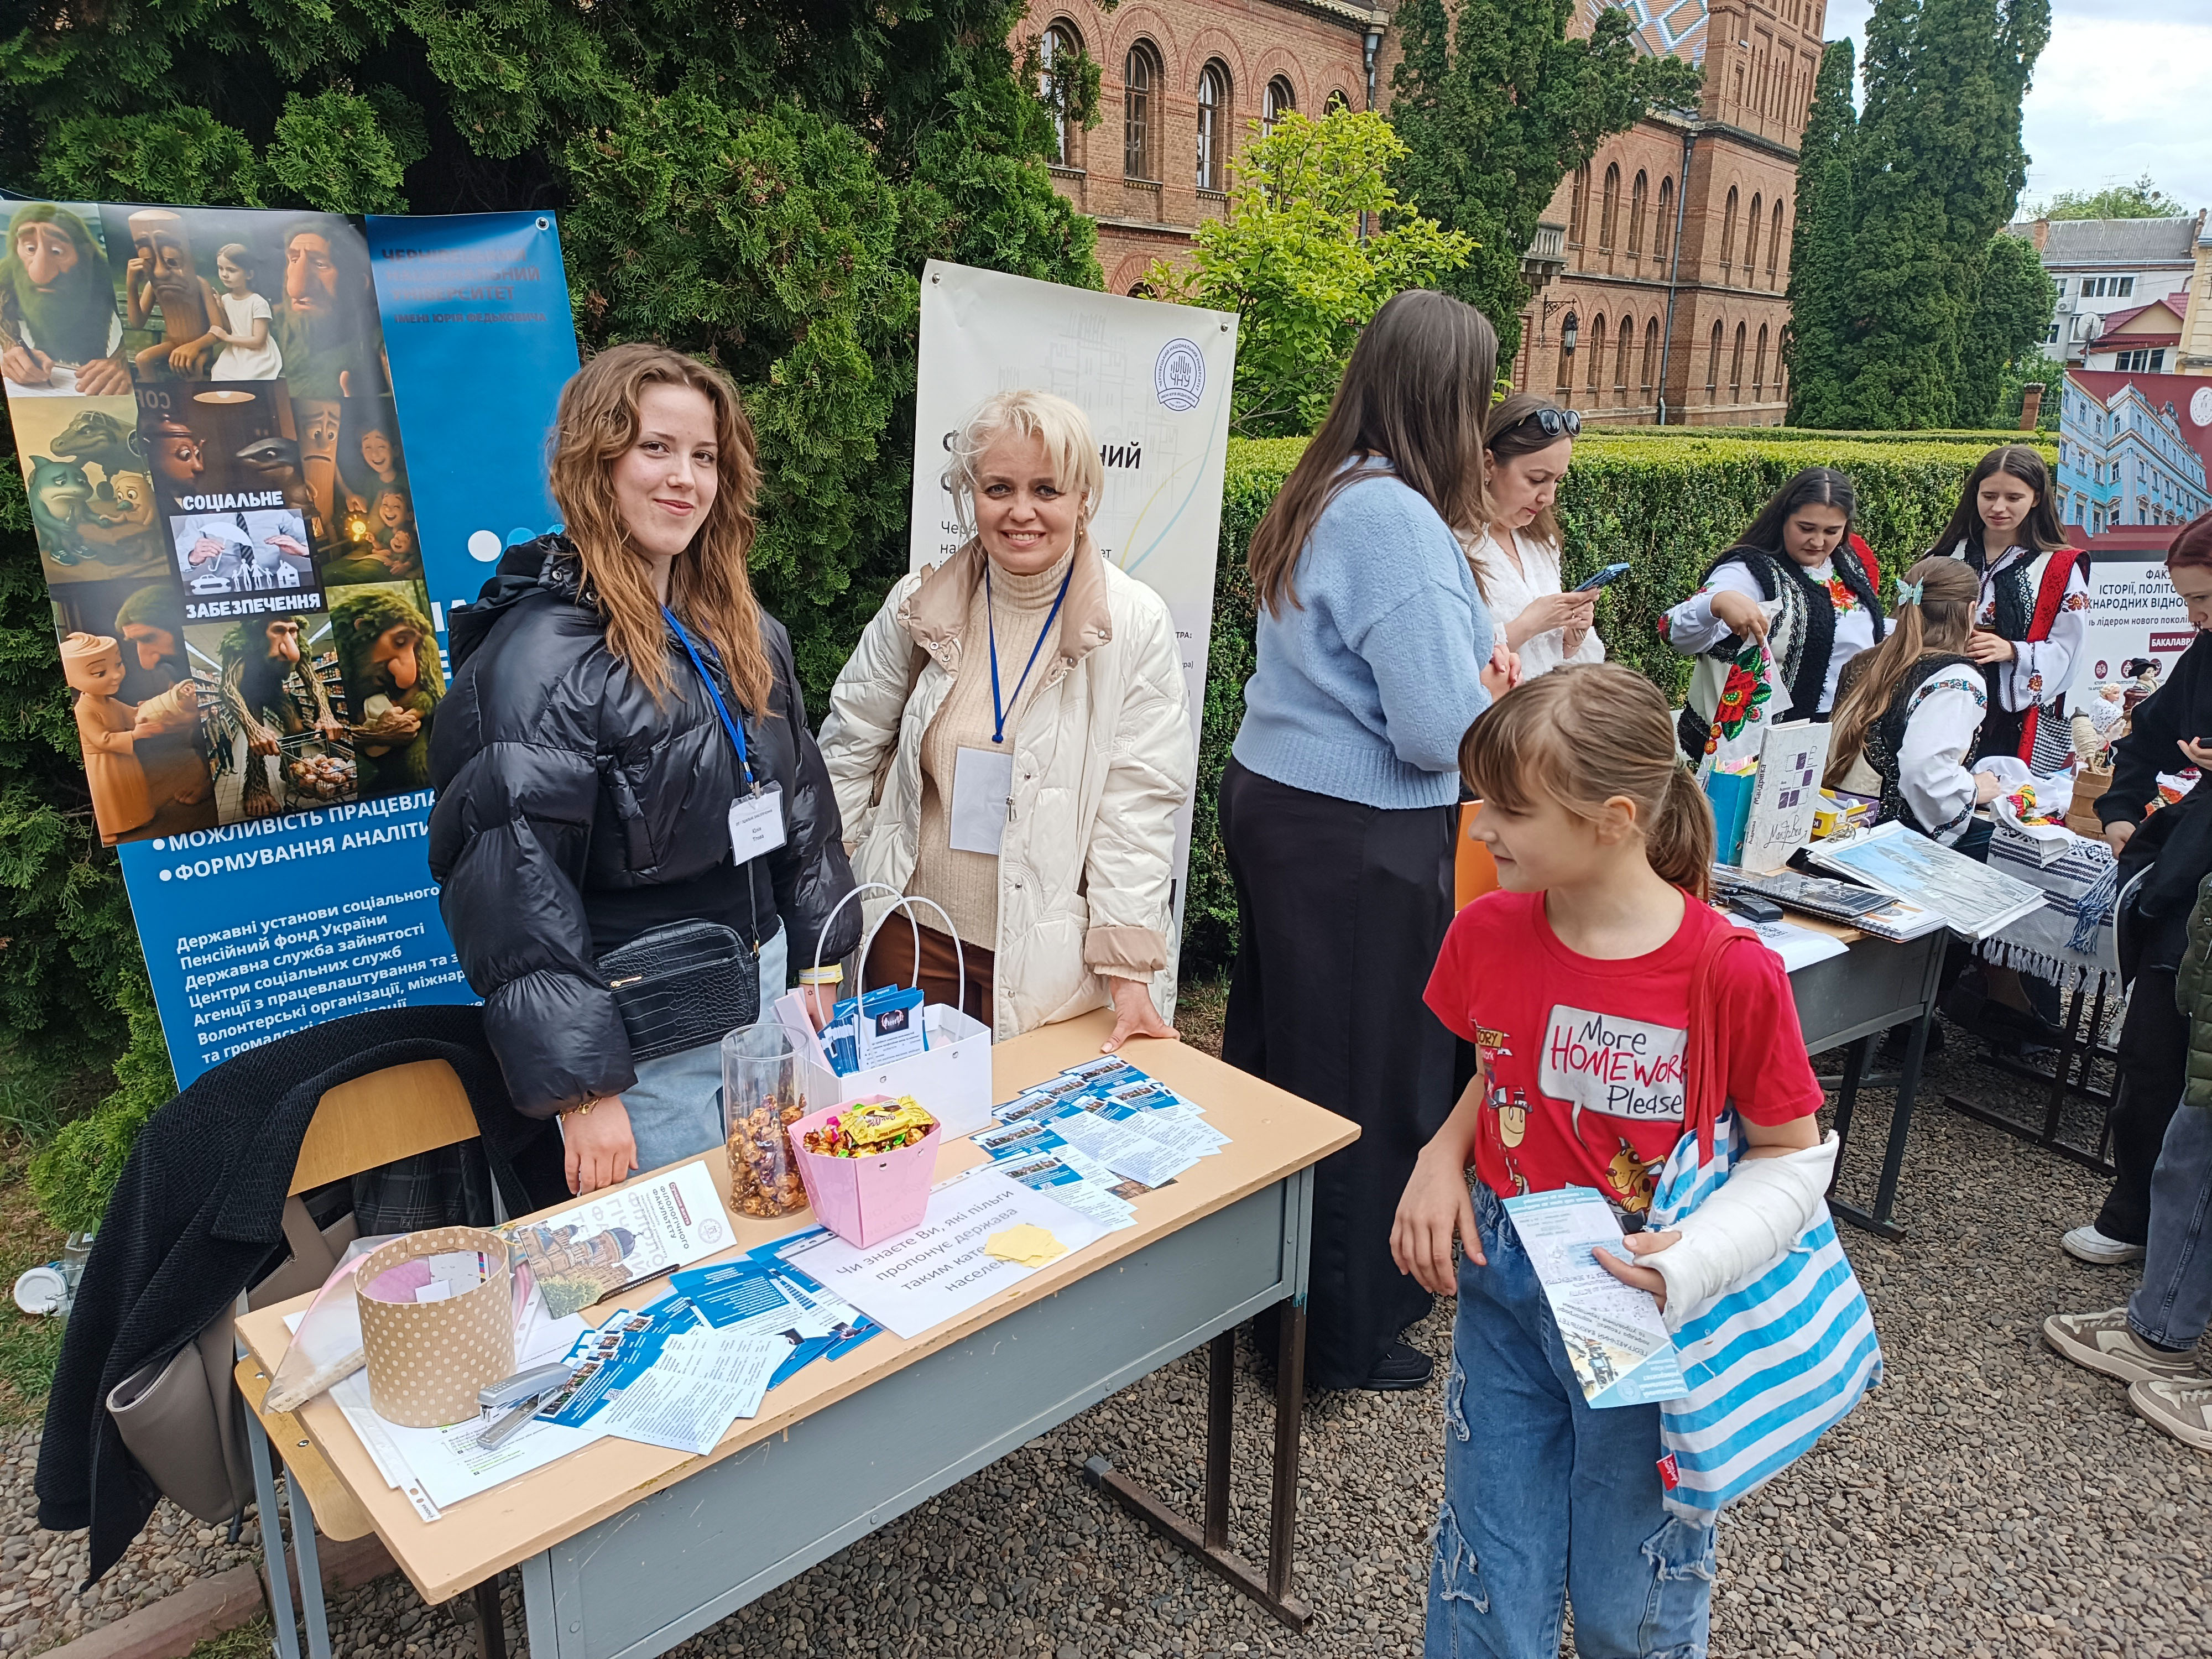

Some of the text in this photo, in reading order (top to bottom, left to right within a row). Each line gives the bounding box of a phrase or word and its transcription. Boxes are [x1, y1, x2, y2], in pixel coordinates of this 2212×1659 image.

[392, 285, 514, 301] УНІВЕРСИТЕТ
[394, 312, 546, 324] ІМЕНІ ЮРІЯ ФЕДЬКОВИЧА
[1170, 372, 1191, 387] ЧНУ
[182, 491, 284, 512] СОЦІАЛЬНЕ
[186, 593, 321, 619] ЗАБЕЗПЕЧЕННЯ
[2099, 581, 2136, 596] ІСТОРІЇ,
[2097, 617, 2130, 628] лідером
[2132, 617, 2159, 625] нового
[2152, 638, 2195, 647] БАКАЛАВР
[1754, 764, 1767, 805] Мандрівка
[169, 811, 323, 852] МОЖЛИВІСТЬ
[175, 837, 336, 881] ФОРМУВАННЯ
[176, 886, 440, 954] Державні установи соціального
[180, 915, 388, 970] Пенсійний фонд України
[185, 922, 425, 992] Державна служба зайнятості
[189, 945, 402, 1008] Центри соціальних служб
[194, 999, 251, 1027] Агенції
[255, 999, 264, 1010] з
[268, 960, 426, 1006] працевлаштування
[430, 956, 448, 968] та
[197, 1004, 307, 1046] Волонтерські
[310, 982, 404, 1015] організації,
[1578, 1014, 1647, 1055] More
[202, 1051, 220, 1064] та
[1477, 1030, 1498, 1045] ORY
[1606, 1084, 1682, 1115] Please
[653, 1189, 677, 1238] ФАКУЛЬТЕТУ
[660, 1186, 689, 1249] ФІЛОЛОГІЧНОГО
[836, 1190, 1015, 1274] Чи знаєте Ви, які пільги
[875, 1207, 1018, 1281] пропонує держава
[901, 1244, 987, 1291] таким кате
